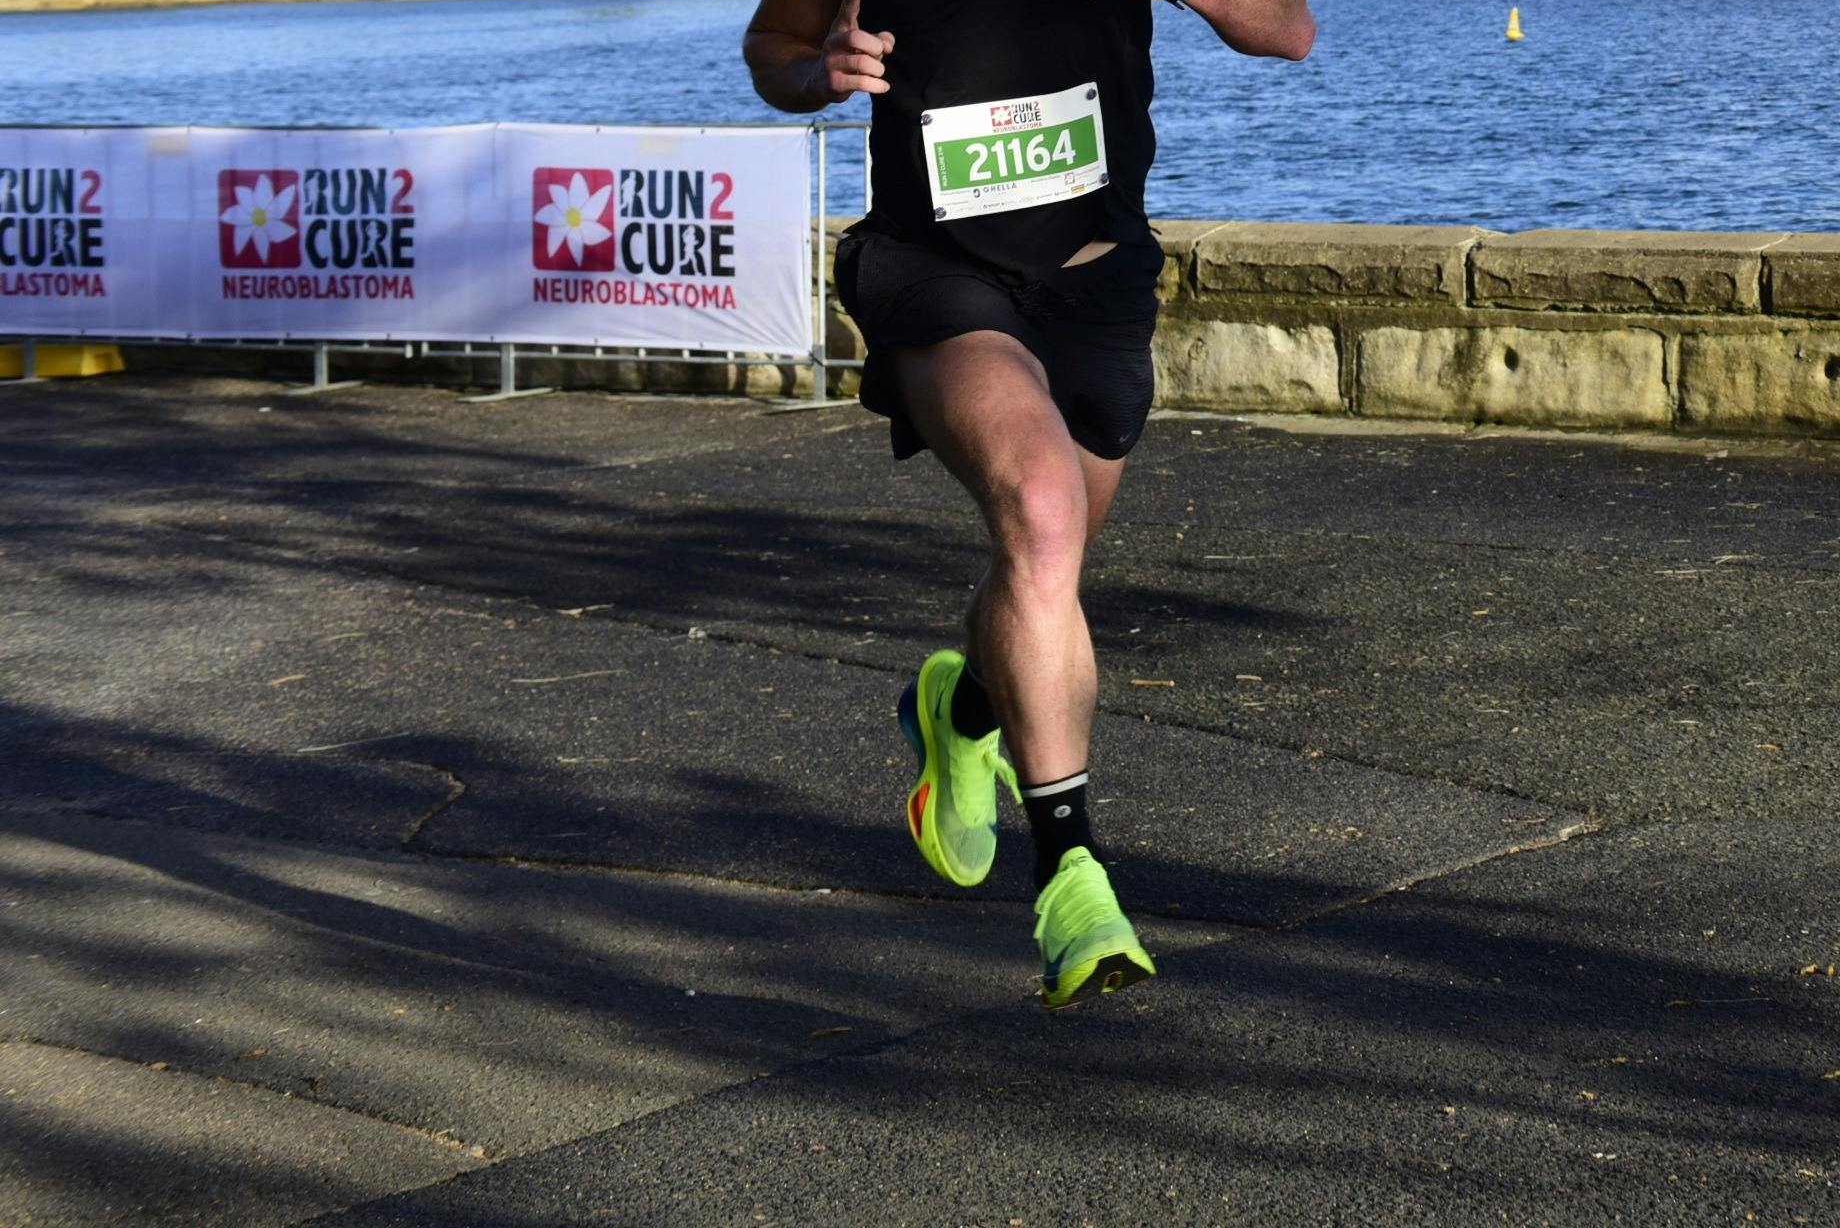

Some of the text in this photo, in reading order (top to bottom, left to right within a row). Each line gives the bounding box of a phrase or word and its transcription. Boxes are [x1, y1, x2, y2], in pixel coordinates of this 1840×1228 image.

[1011, 101, 1040, 114] RUN2
[1013, 111, 1042, 124] CURE
[965, 128, 1076, 182] 21164
[304, 168, 415, 215] RUN2
[620, 169, 734, 220] RUN2
[0, 217, 104, 267] CURE
[305, 218, 415, 269] CURE
[621, 222, 736, 277] CURE
[0, 273, 107, 297] LASTOMA
[222, 275, 415, 300] NEUROBLASTOMA
[533, 277, 737, 310] NEUROBLASTOMA
